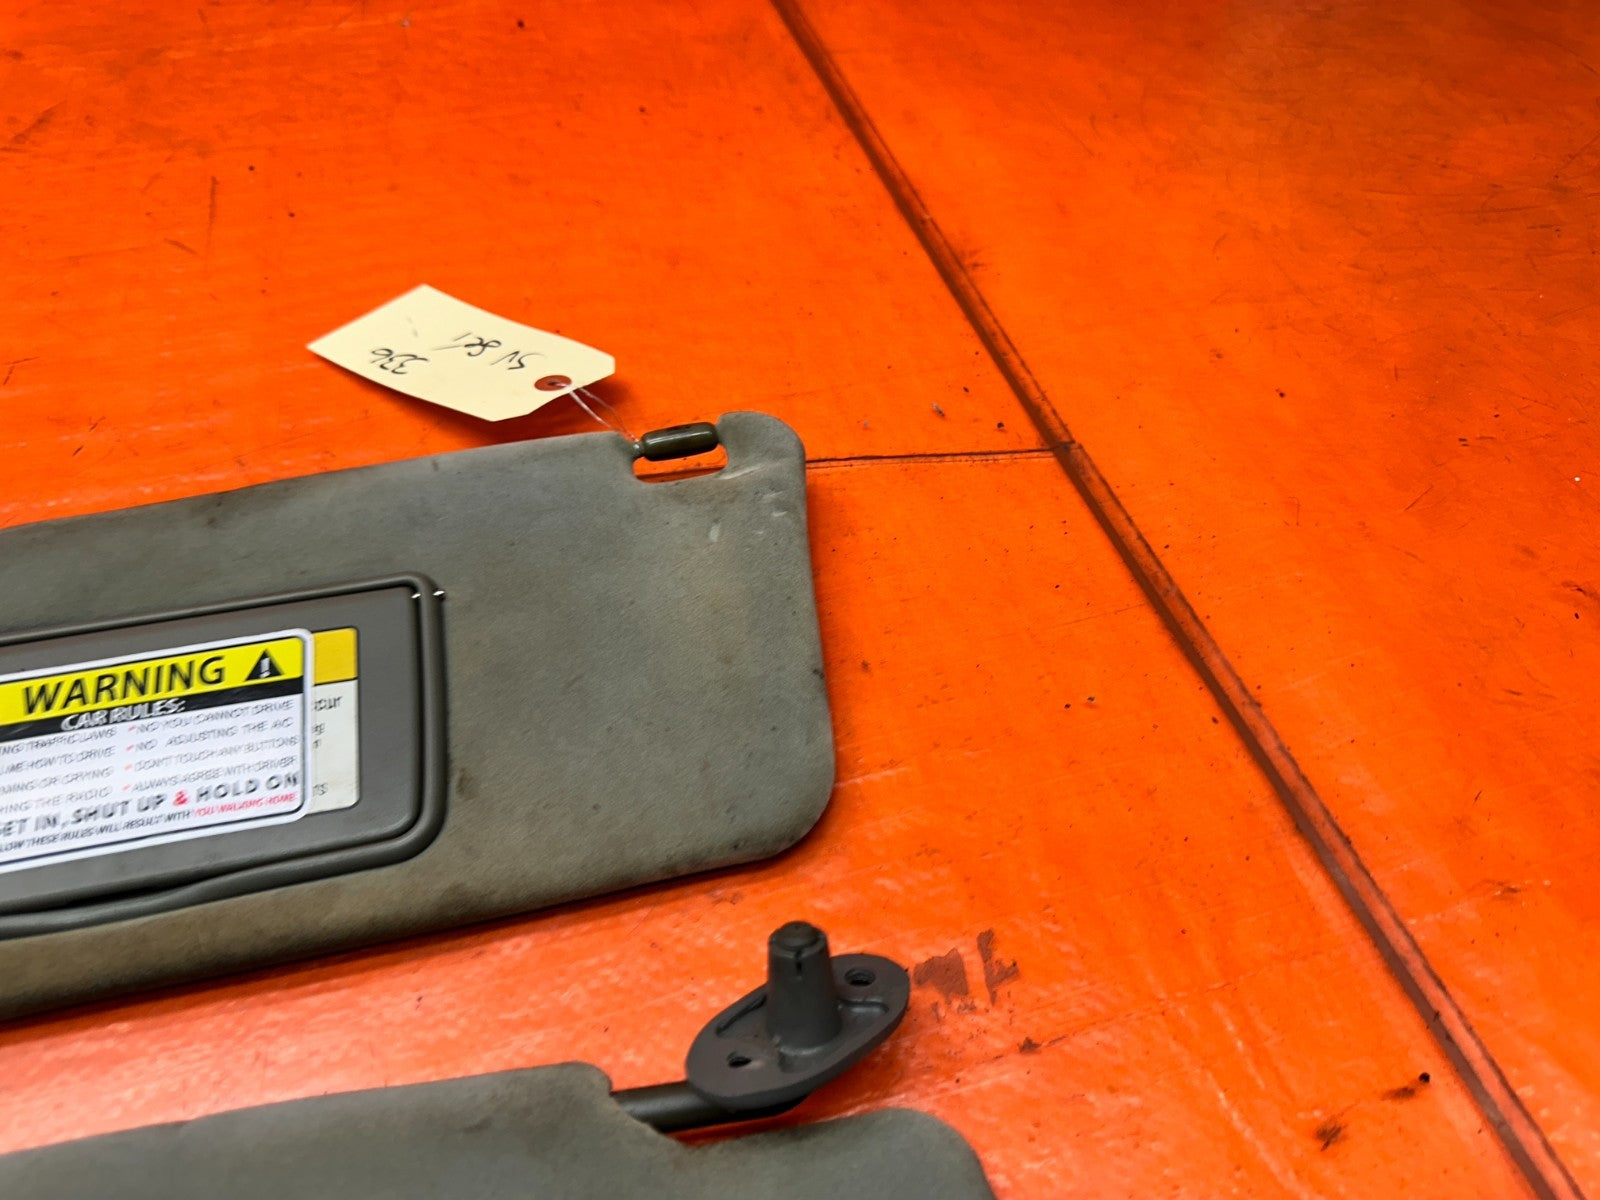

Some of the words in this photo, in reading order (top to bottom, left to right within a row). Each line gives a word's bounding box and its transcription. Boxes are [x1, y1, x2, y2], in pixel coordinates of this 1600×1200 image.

[22, 655, 225, 714] WARNING
[60, 706, 108, 731] CAR
[109, 697, 187, 724] RULES:
[163, 716, 191, 729] YOU
[194, 706, 250, 725] CANNOT
[251, 699, 294, 716] DRIVE
[25, 733, 79, 752] TRAFFIC
[79, 728, 118, 744] LAWS
[165, 725, 239, 747] ADJUSTING
[241, 720, 269, 735] THE
[77, 745, 117, 762] DRIVE
[174, 748, 218, 764] TOUCH
[217, 743, 243, 757] ANY
[243, 735, 299, 753] BUTTONS
[60, 765, 114, 785] CRYING
[132, 774, 179, 792] ALWAYS
[181, 767, 222, 783] AGREE
[224, 762, 252, 776] WITH
[251, 754, 298, 772] DRIVER
[65, 786, 113, 802] RADIO
[70, 799, 130, 824] SHUT
[137, 794, 167, 813] UP
[172, 790, 189, 807] &
[195, 779, 259, 803] HOLD
[265, 771, 301, 790] ON
[25, 832, 61, 848] THESE
[60, 825, 96, 842] RULES
[95, 820, 124, 836] WILL
[123, 814, 164, 831] RESULT
[166, 809, 191, 821] WITH
[193, 804, 216, 817] YOU
[217, 797, 264, 812] WALKING
[266, 792, 297, 805] HOME
